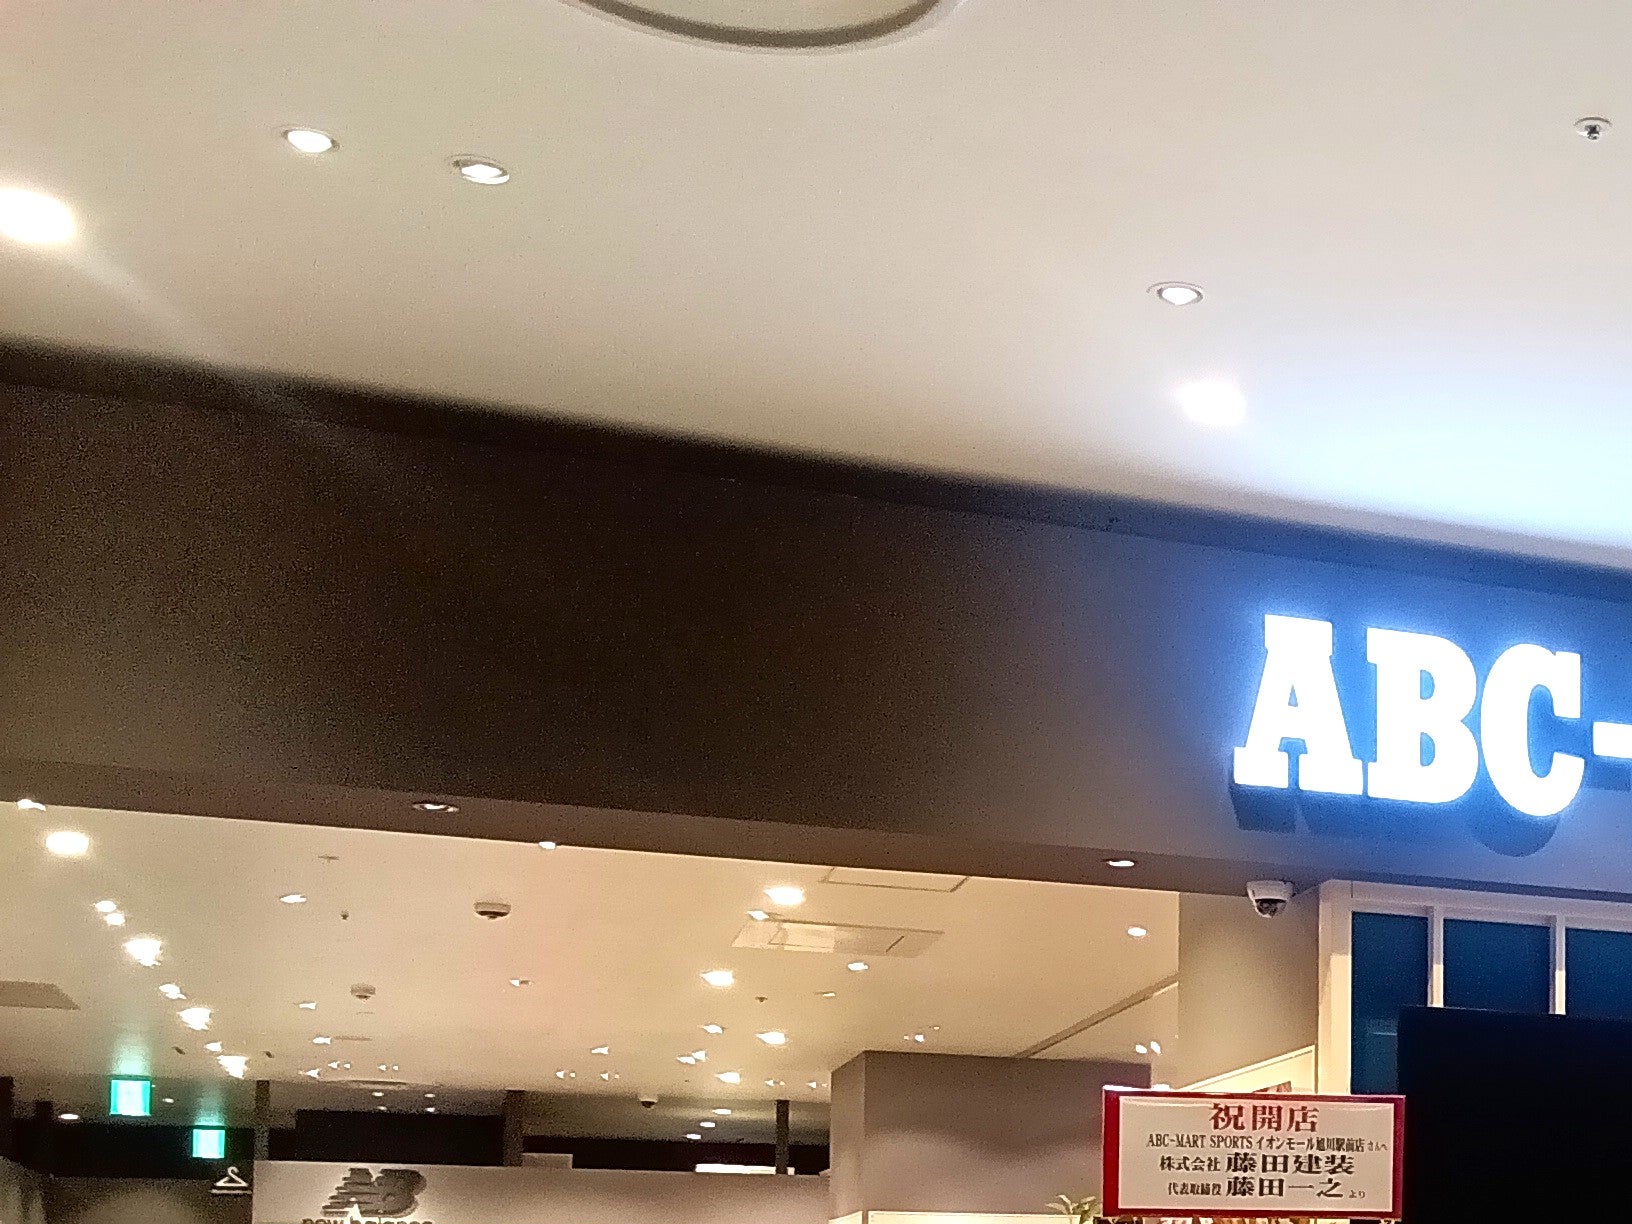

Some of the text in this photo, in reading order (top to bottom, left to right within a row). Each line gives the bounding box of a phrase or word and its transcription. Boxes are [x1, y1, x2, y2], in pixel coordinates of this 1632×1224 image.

[1209, 1102, 1320, 1133] 祝開店
[1147, 1133, 1206, 1149] ABC-MART
[1209, 1135, 1253, 1150] SPORTS
[1159, 1152, 1355, 1175] 株式会社 藤田建装
[1226, 1176, 1344, 1199] 藤田一之
